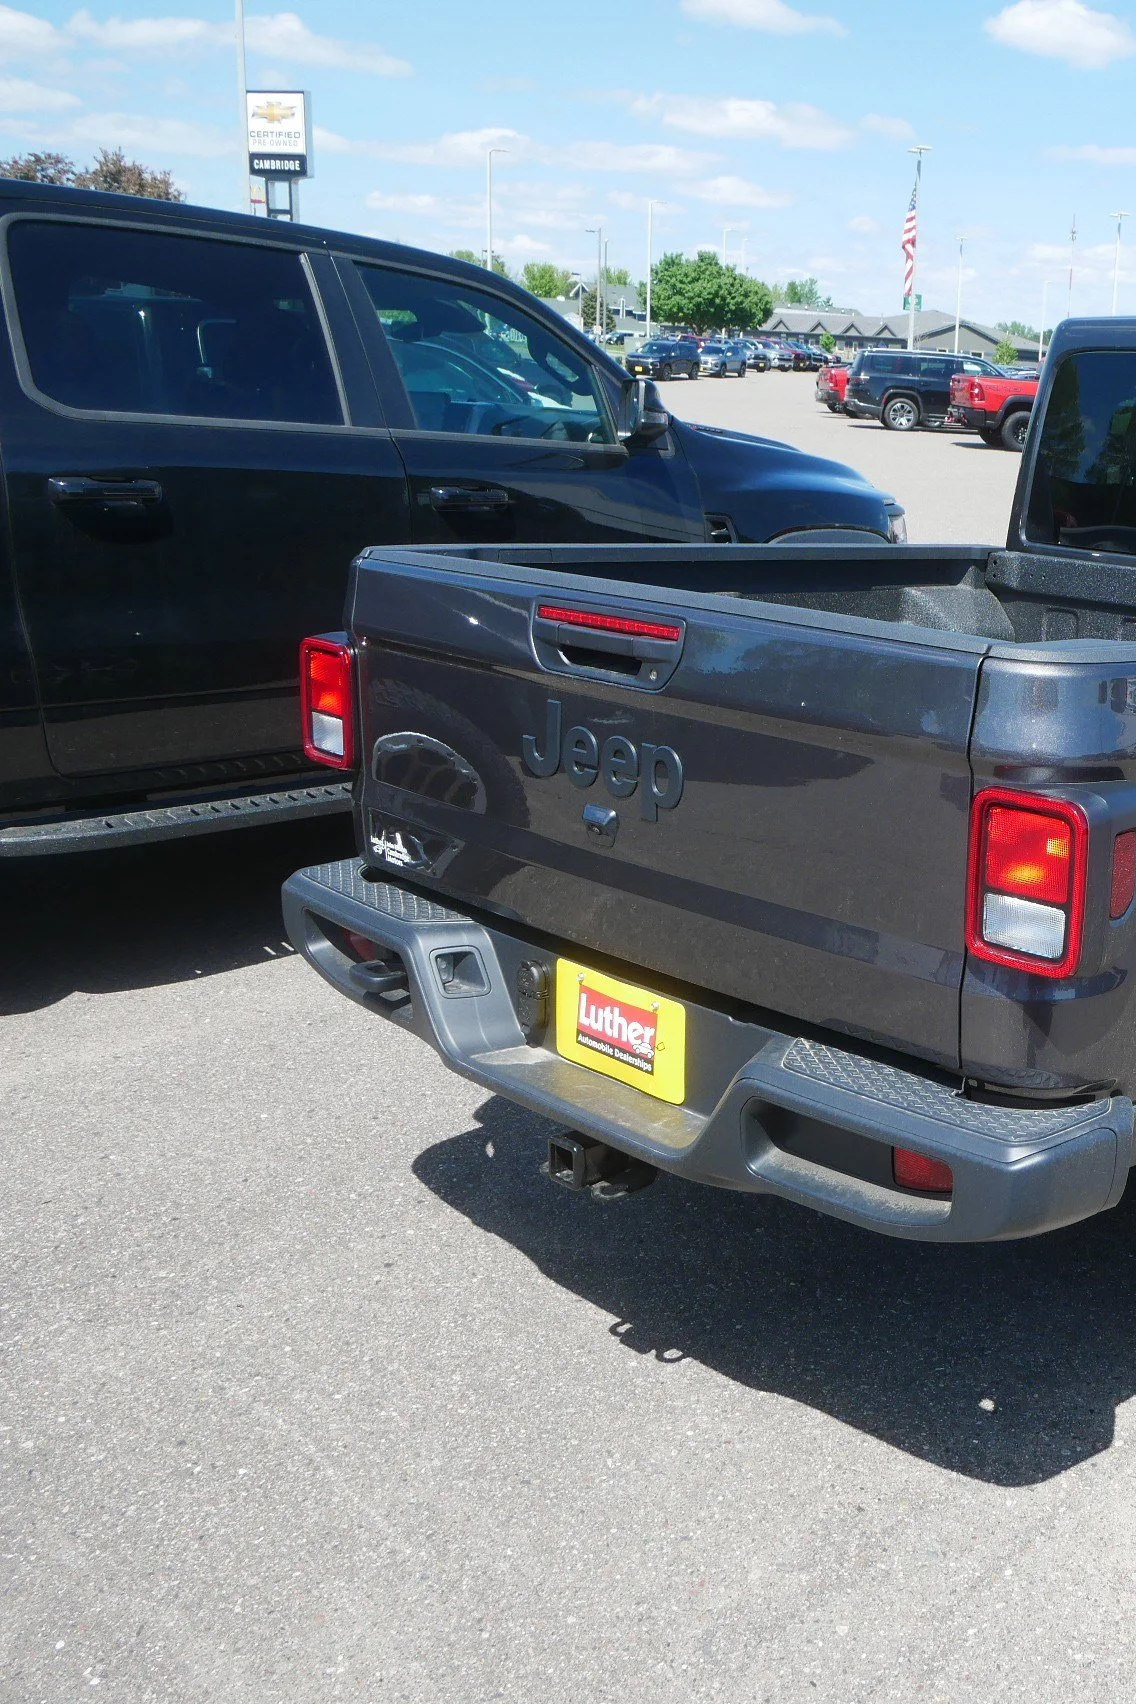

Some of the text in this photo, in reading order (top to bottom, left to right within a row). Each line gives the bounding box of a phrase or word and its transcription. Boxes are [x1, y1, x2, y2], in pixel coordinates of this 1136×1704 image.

[249, 130, 301, 139] CERTIFIED
[253, 159, 301, 171] CAMBRIDGE
[521, 699, 685, 823] Jeep
[578, 992, 656, 1044] Luther
[577, 1033, 652, 1072] Automobile Dealerships
